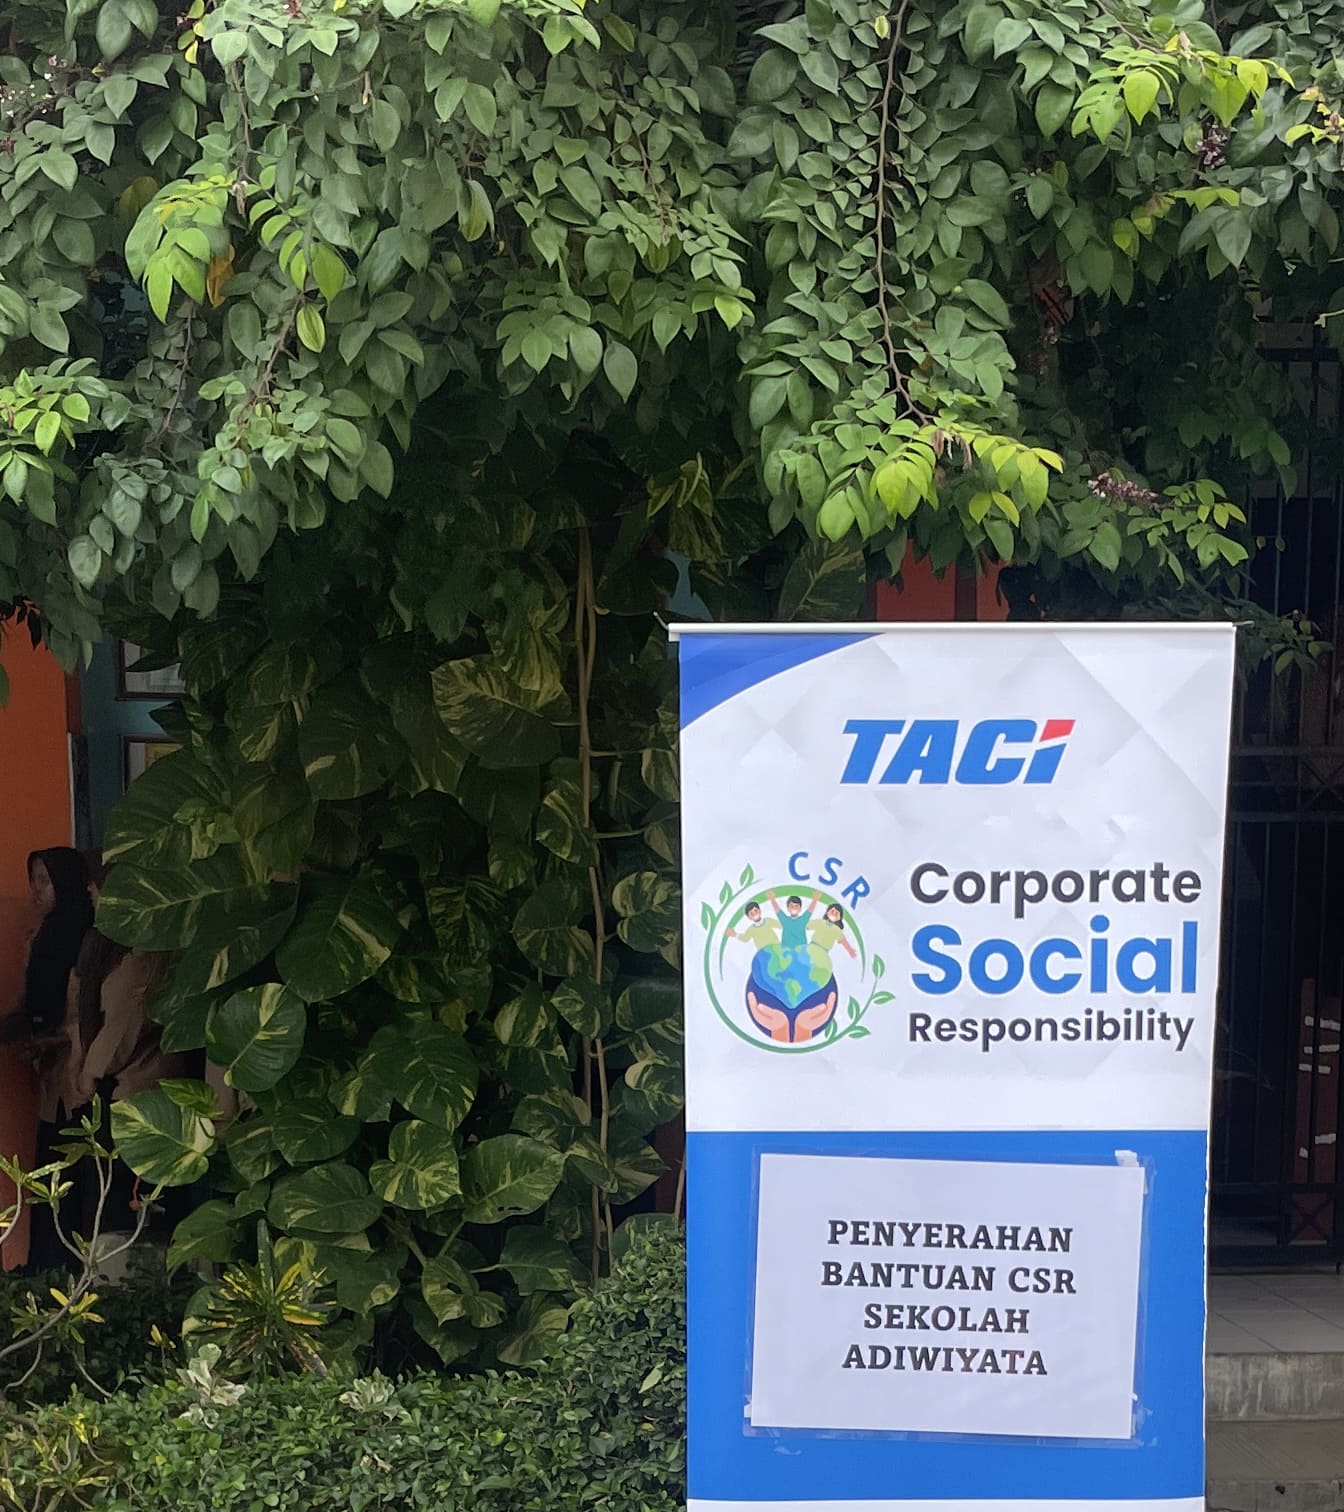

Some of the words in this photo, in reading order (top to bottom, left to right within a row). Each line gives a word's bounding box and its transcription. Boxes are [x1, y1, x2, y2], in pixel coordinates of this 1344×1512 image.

[788, 851, 870, 910] CSR
[909, 862, 1202, 918] Corporate
[911, 914, 1198, 995] Social
[908, 1009, 1194, 1052] Responsibility
[827, 1219, 1073, 1253] PENYERAHAN
[821, 1260, 995, 1291] BANTUAN
[1008, 1267, 1076, 1295] CSR
[863, 1303, 1030, 1334] SEKOLAH
[842, 1344, 1048, 1375] ADIWIYATA
